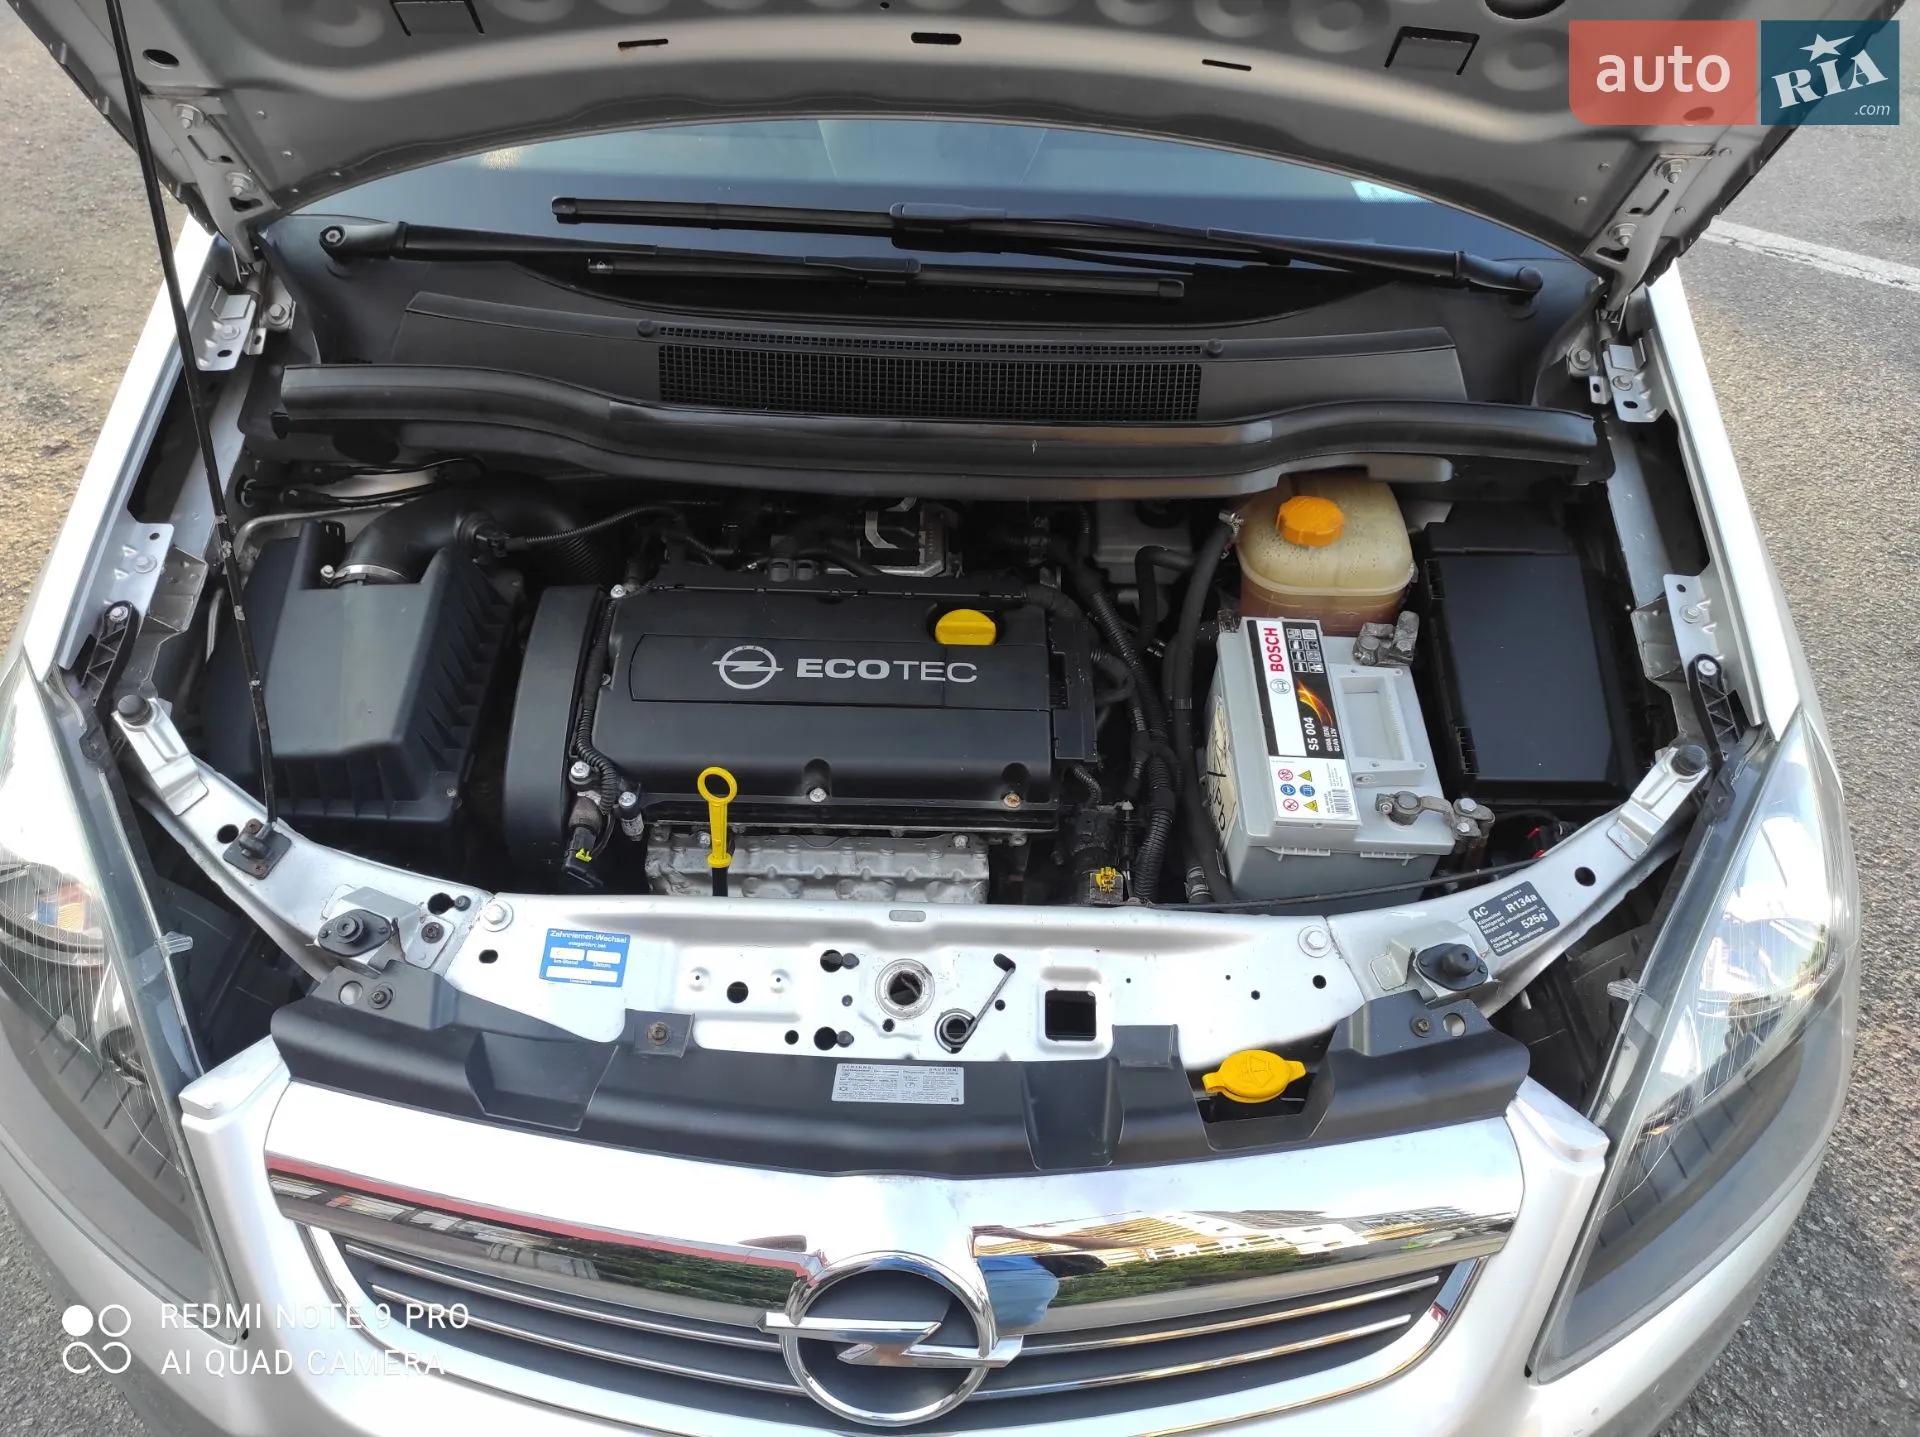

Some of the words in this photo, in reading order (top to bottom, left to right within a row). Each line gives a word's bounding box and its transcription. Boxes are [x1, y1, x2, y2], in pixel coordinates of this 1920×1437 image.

[1264, 627, 1285, 672] BOSCH
[796, 658, 978, 683] ECOTEC
[1303, 717, 1316, 736] 004
[1307, 738, 1319, 751] S5
[1505, 894, 1538, 913] R134a
[1473, 906, 1489, 919] AC
[1521, 913, 1548, 929] 525g
[550, 930, 627, 943] Zahnriemen-Wechsel
